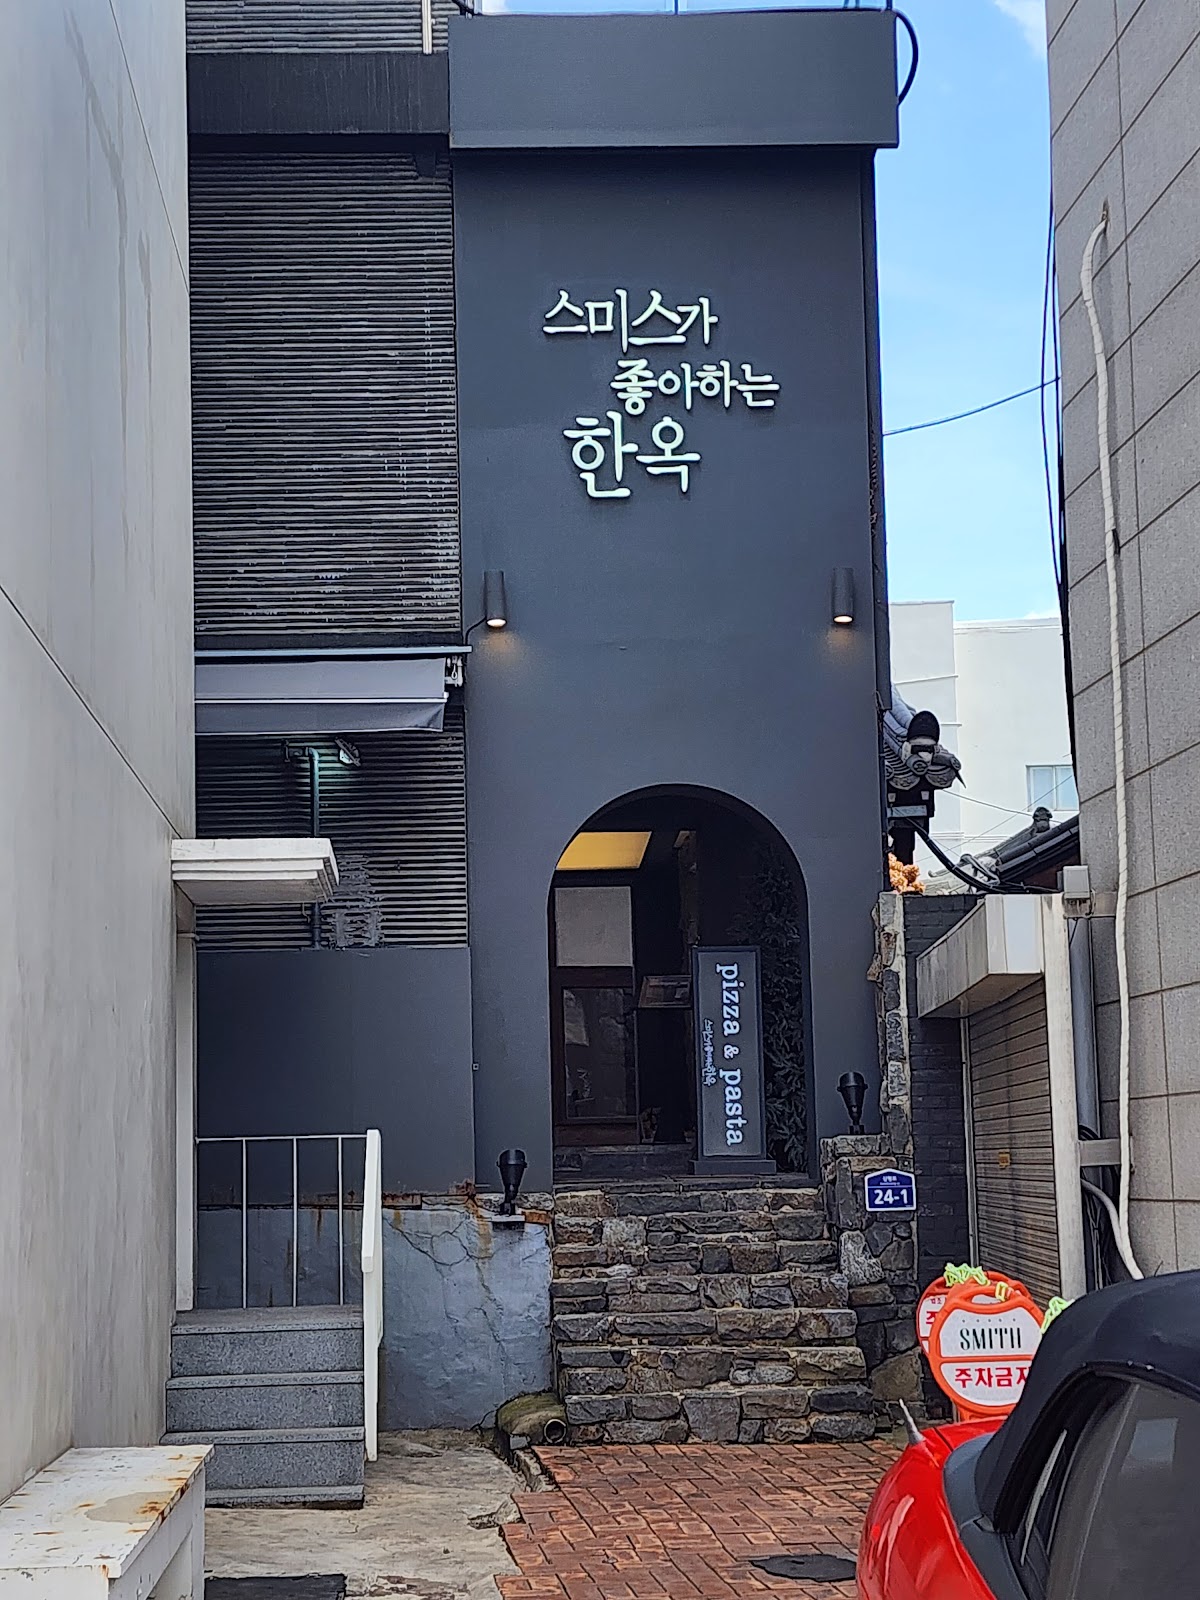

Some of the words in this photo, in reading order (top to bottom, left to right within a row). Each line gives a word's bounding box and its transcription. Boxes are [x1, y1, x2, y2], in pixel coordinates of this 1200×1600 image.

[542, 288, 719, 353] 스미스가
[610, 358, 780, 416] 좋아하는
[563, 410, 701, 498] 한옥
[716, 963, 745, 1036] pizza
[723, 1044, 740, 1059] &
[719, 1068, 747, 1146] pasta
[873, 1188, 908, 1205] 24-1
[959, 1327, 1022, 1351] SMITH
